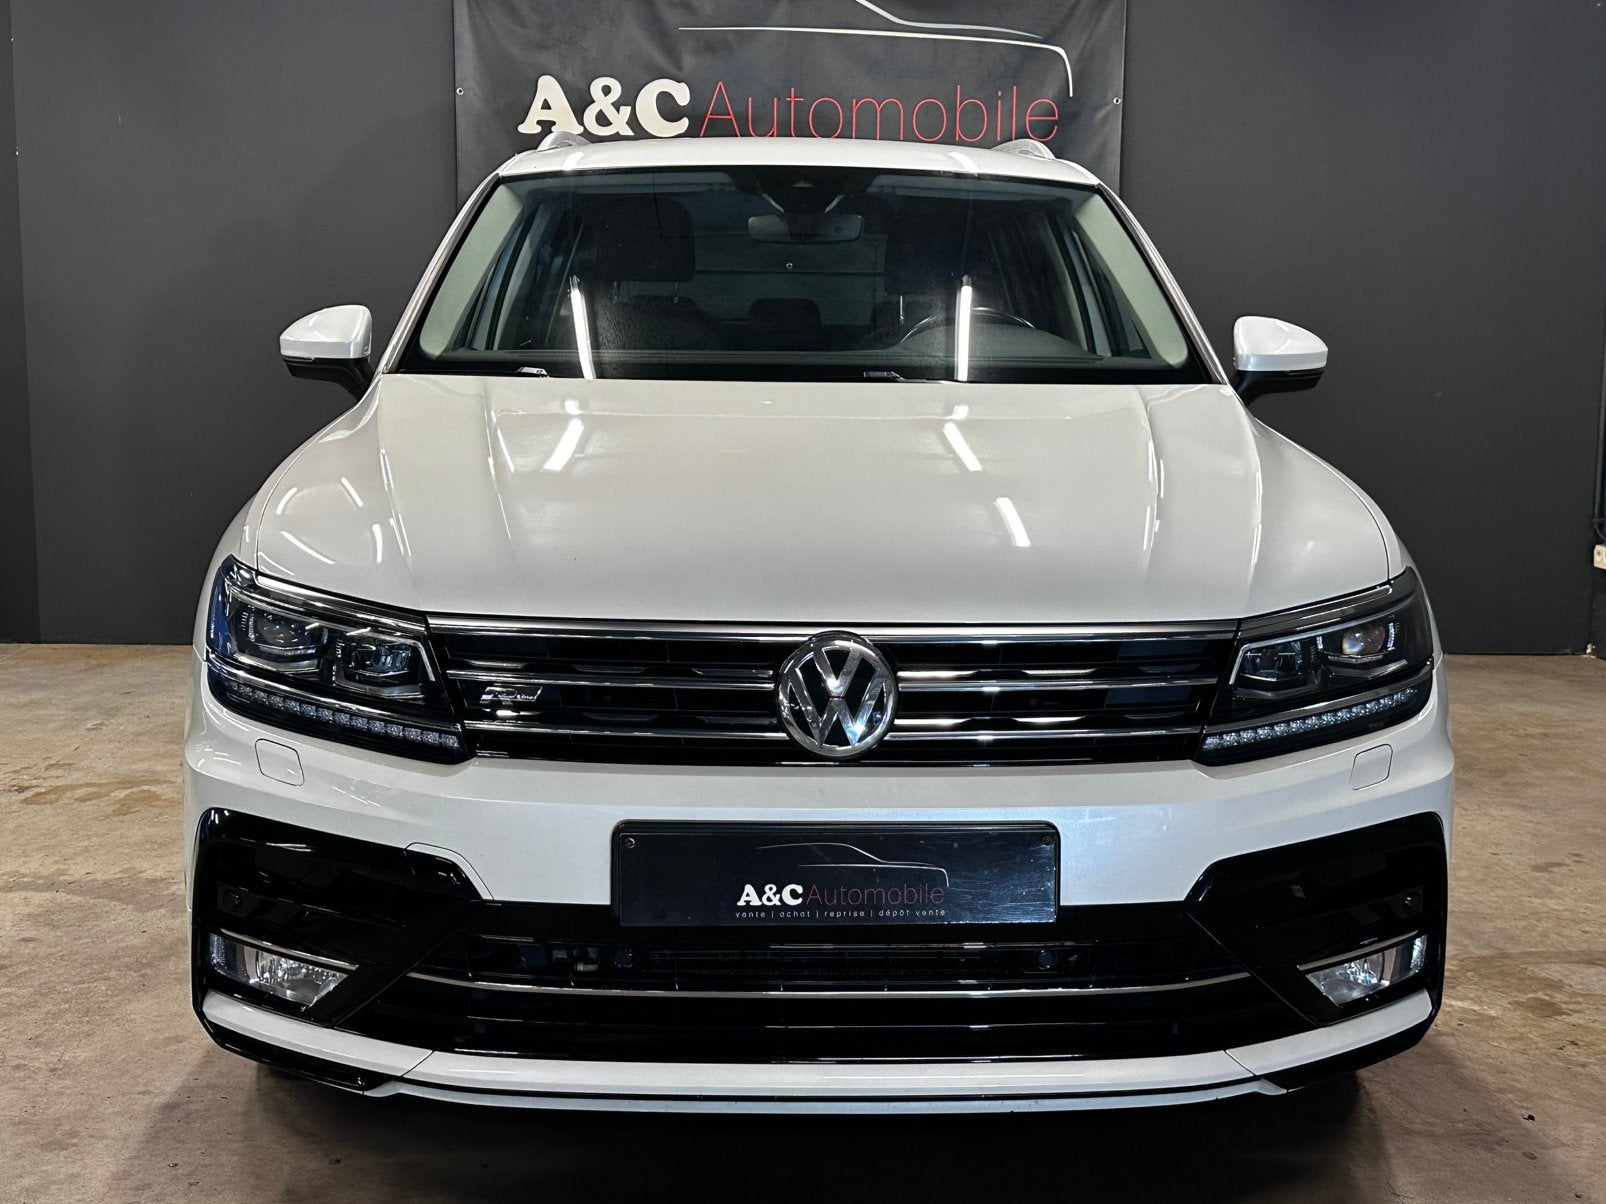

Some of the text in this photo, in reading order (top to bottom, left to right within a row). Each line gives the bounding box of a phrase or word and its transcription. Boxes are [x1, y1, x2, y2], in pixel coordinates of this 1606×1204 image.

[517, 75, 1060, 142] A&C Automobile
[736, 883, 945, 906] A&C Automobile
